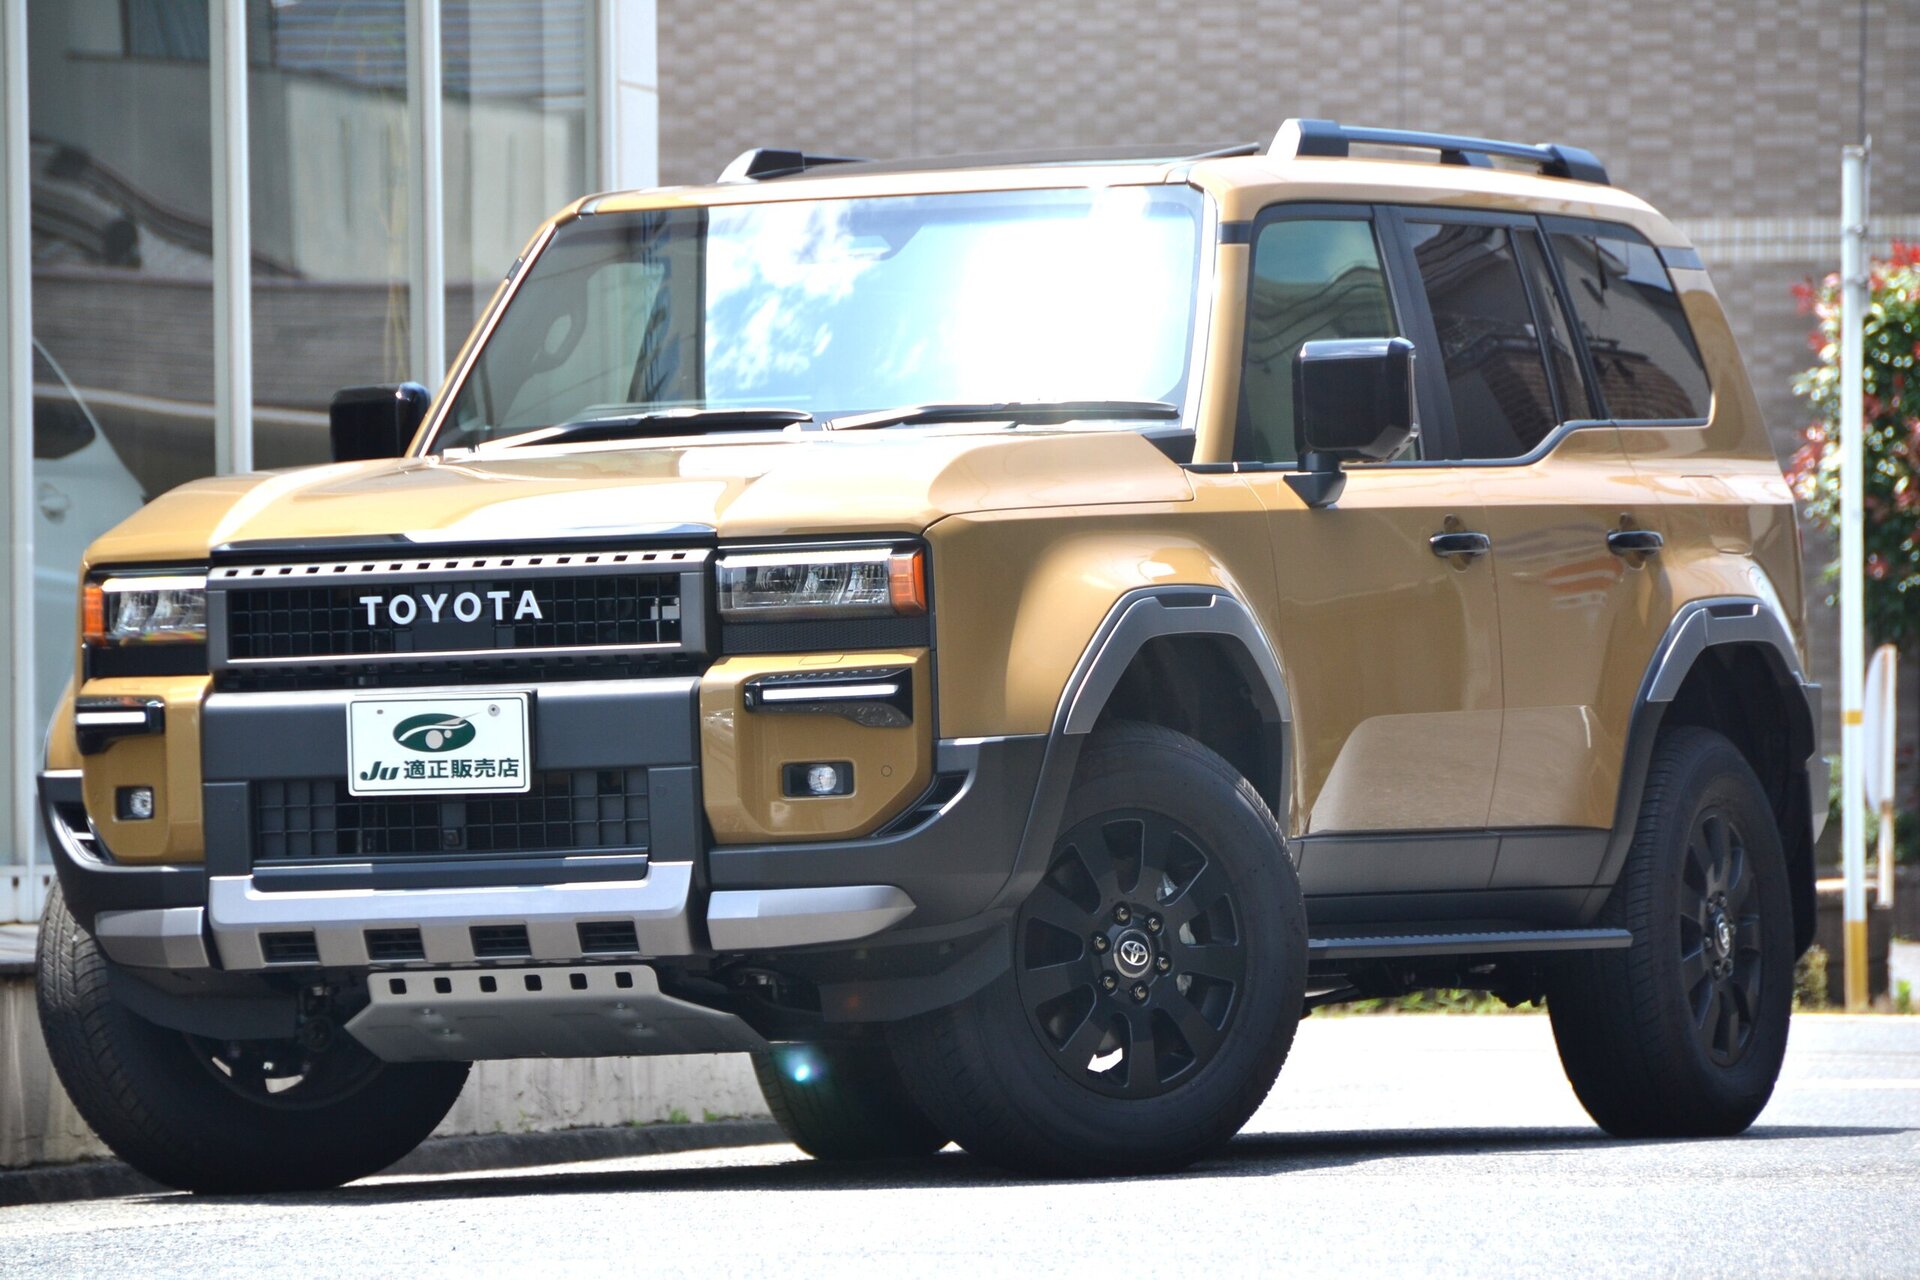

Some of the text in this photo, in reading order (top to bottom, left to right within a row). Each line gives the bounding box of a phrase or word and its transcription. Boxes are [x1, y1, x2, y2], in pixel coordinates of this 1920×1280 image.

[359, 590, 543, 626] TOYOTA
[403, 757, 520, 780] 適正販売店
